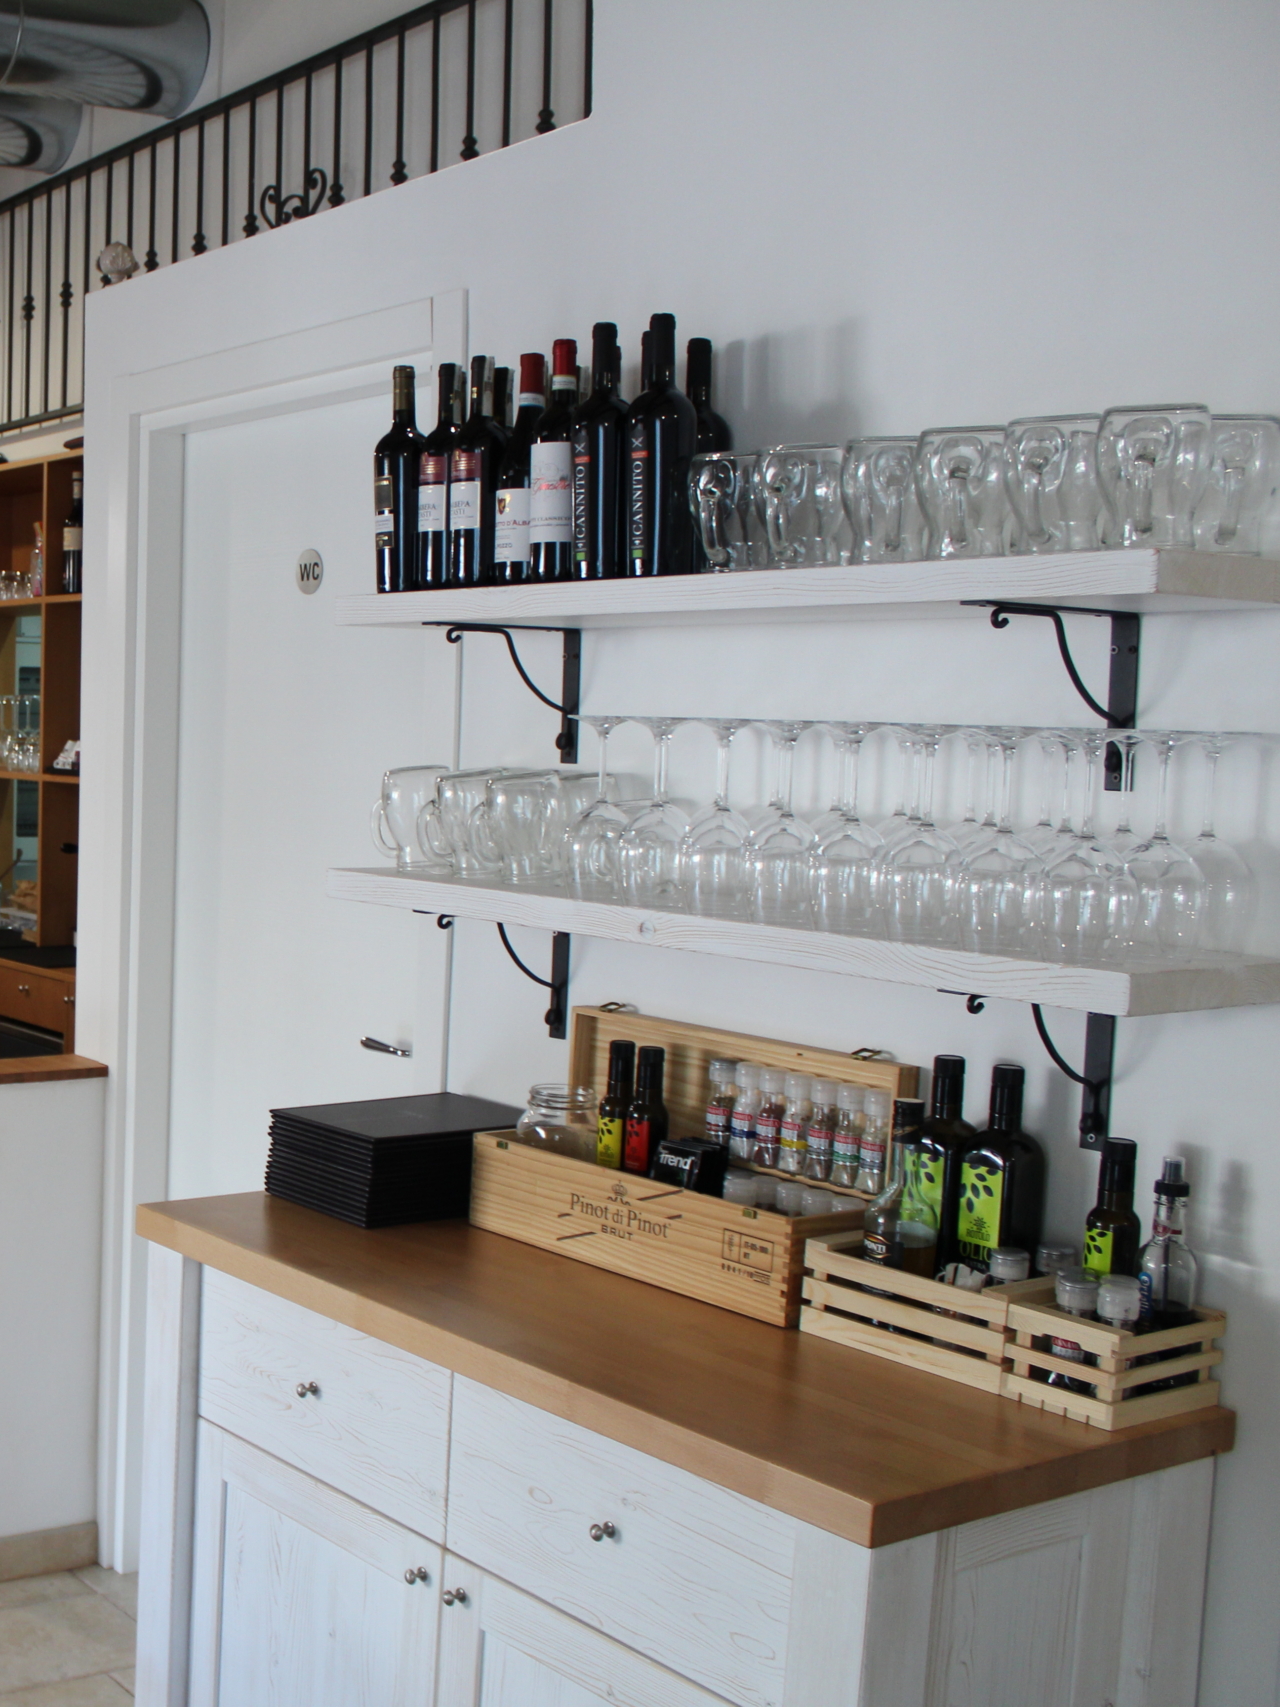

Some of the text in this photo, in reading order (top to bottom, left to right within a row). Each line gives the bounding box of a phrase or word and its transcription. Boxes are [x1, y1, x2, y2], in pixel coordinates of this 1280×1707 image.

[575, 465, 586, 538] CANNITO
[632, 460, 644, 535] CANNITO
[299, 562, 320, 582] WC
[658, 1154, 694, 1170] Trend
[569, 1193, 670, 1239] Pinot di Pinot
[601, 1224, 633, 1241] BRUT
